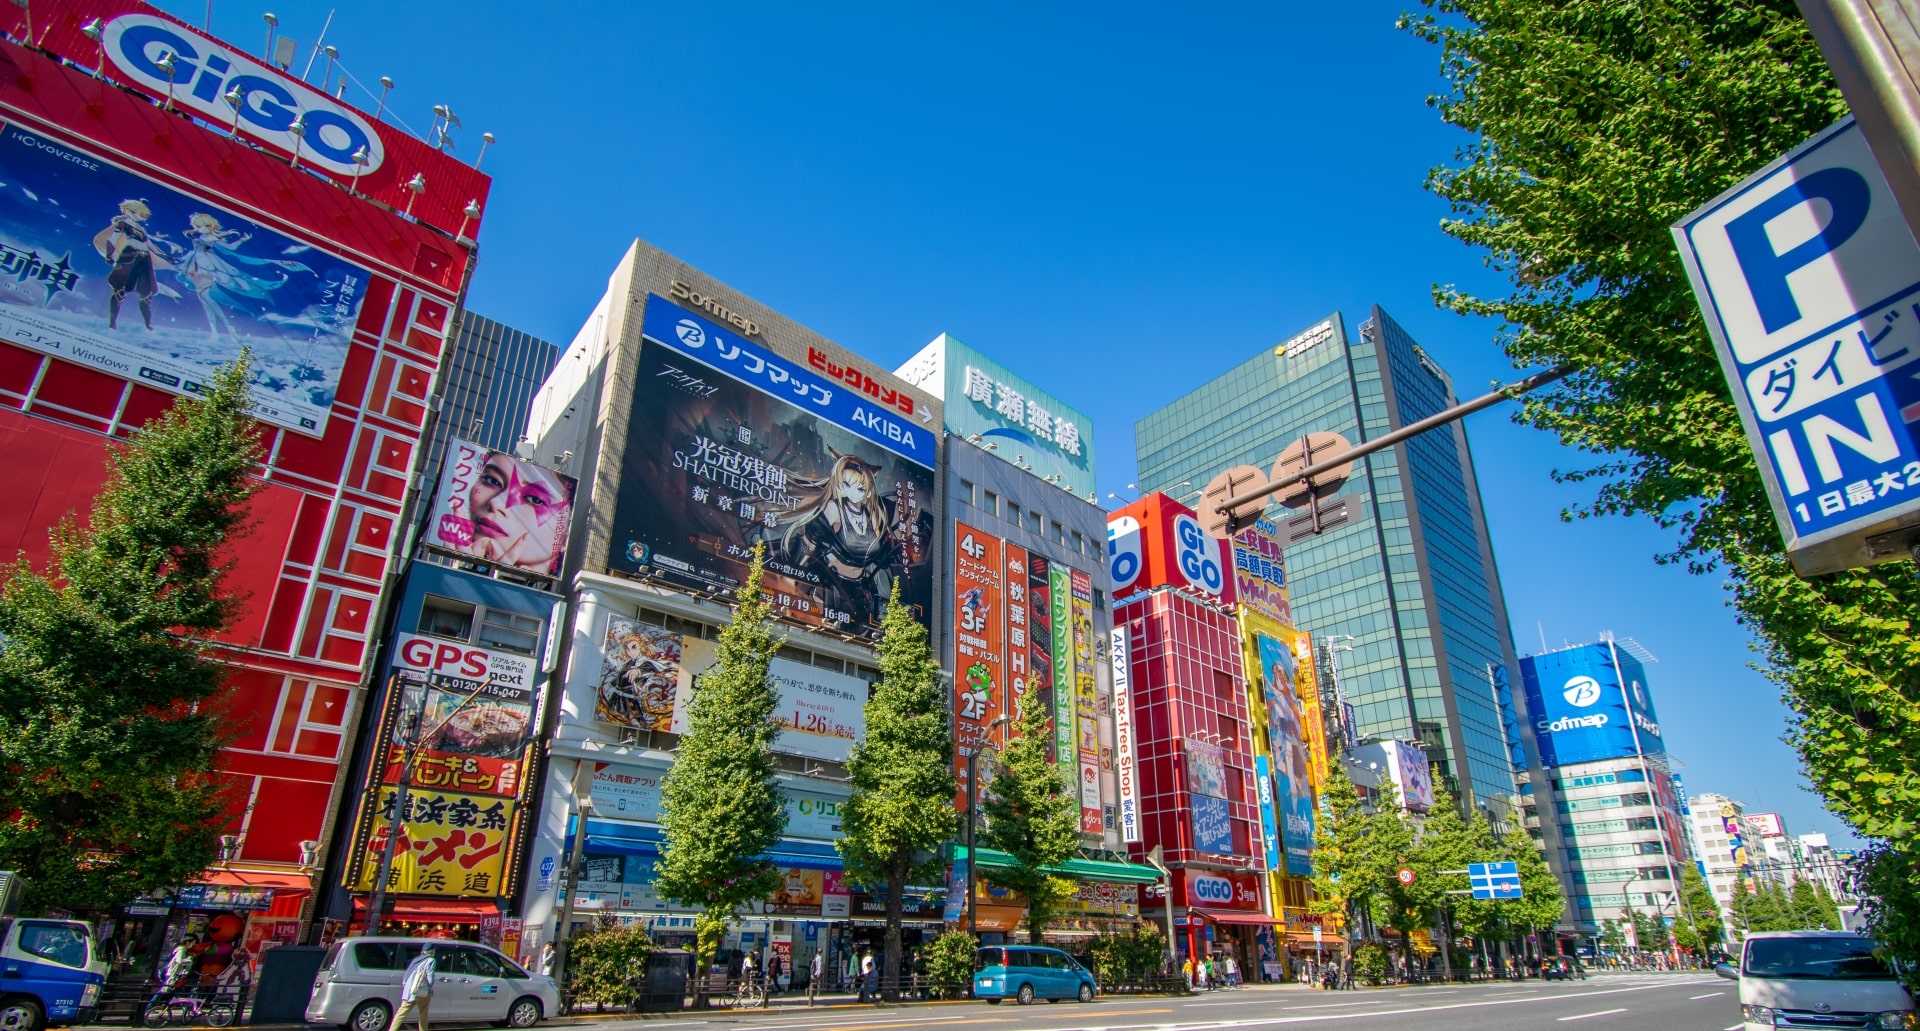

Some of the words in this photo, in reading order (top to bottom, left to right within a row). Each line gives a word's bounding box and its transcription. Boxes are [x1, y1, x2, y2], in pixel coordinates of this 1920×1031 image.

[119, 23, 370, 165] GiGO
[1724, 167, 1872, 336] P
[669, 278, 761, 337] Sofmap
[15, 328, 62, 350] PS4
[71, 345, 131, 373] Windows
[714, 335, 833, 407] ソフマップ
[1761, 301, 1920, 414] ダイビ
[806, 345, 914, 416] ビックカメラ
[963, 363, 1082, 457] 廣瀬無線
[851, 406, 916, 451] AKIBA
[1768, 391, 1901, 498] IN
[447, 445, 477, 512] ワクワク
[672, 450, 801, 512] SHATTERPOINT
[691, 484, 778, 528] 新章開幕
[960, 533, 985, 560] 4F
[959, 557, 999, 579] カードゲーム
[959, 568, 1000, 590] オンラインゲーム
[1182, 549, 1221, 590] GO
[823, 607, 850, 624] 16:00
[960, 605, 985, 633] 3F
[401, 638, 489, 678] GPS
[488, 671, 525, 686] next
[959, 691, 986, 720] 2F
[1112, 633, 1125, 674] AKKY
[1121, 756, 1132, 797] Shop
[793, 710, 828, 735] 1.26
[834, 723, 856, 740] 発売
[1536, 712, 1609, 735] Sofmap
[497, 762, 518, 794] 2F
[1260, 775, 1270, 804] GiGO
[540, 862, 554, 872] 437
[1401, 872, 1411, 881] 50
[1076, 885, 1093, 899] ree
[1196, 878, 1232, 900] GiGO
[773, 943, 790, 953] Tax
